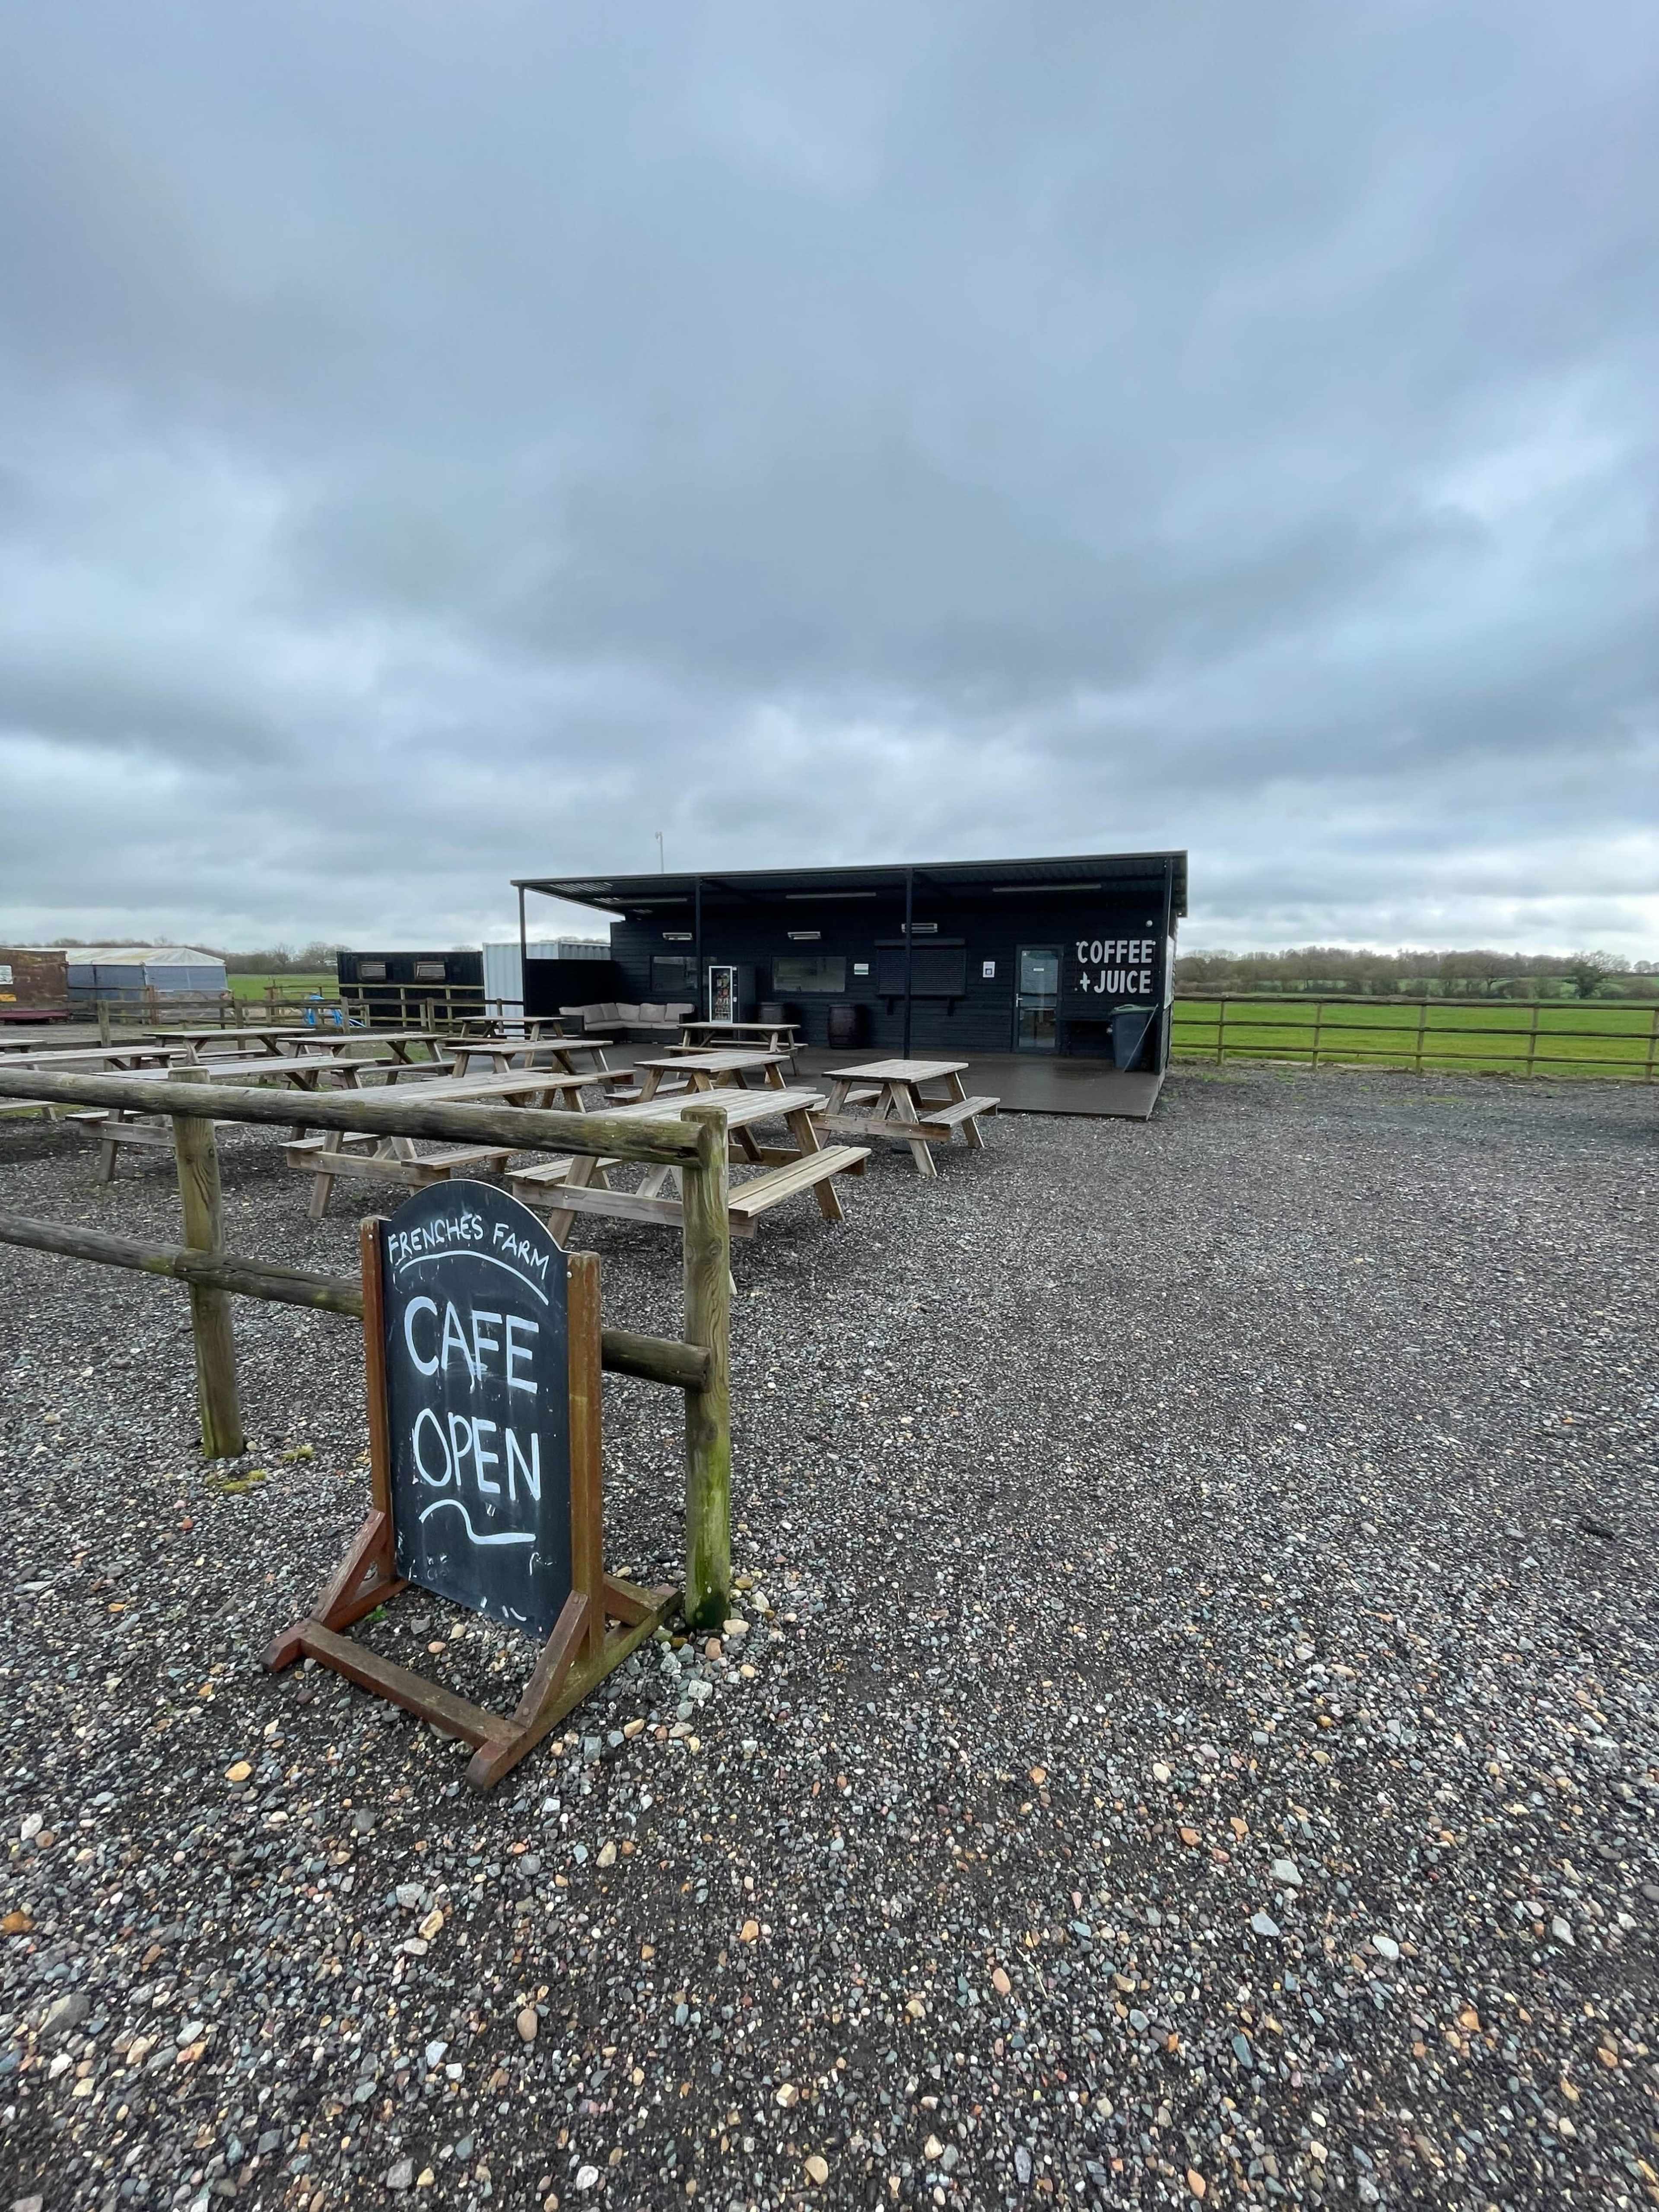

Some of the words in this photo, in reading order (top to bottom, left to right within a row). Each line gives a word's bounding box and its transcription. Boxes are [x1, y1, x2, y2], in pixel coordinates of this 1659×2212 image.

[1077, 940, 1153, 963] COFFEE
[1094, 970, 1151, 993] JUICE
[493, 1222, 550, 1280] FARM
[404, 1296, 539, 1394] CAFE
[413, 1408, 541, 1501] OPEN
